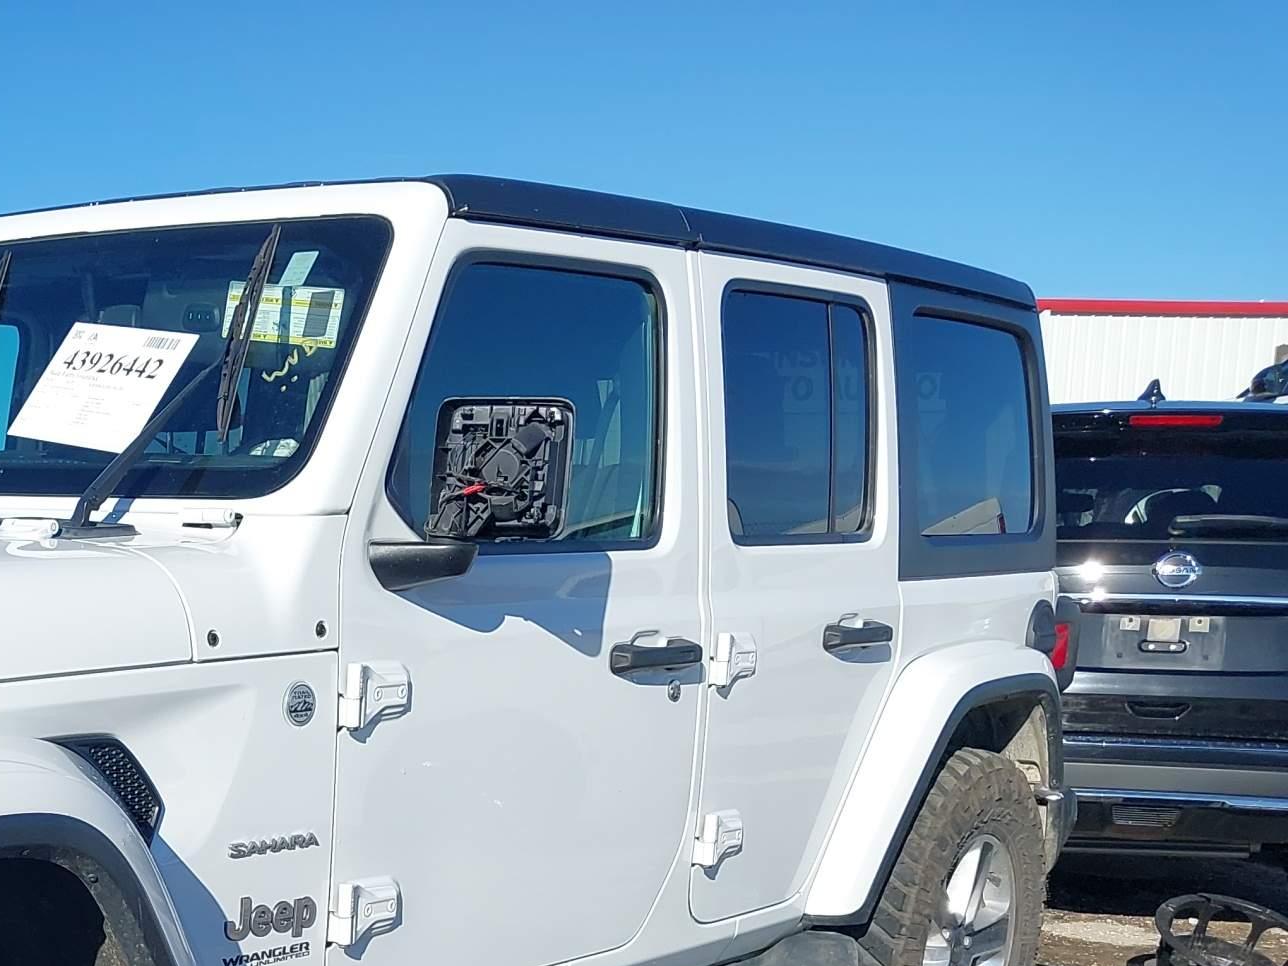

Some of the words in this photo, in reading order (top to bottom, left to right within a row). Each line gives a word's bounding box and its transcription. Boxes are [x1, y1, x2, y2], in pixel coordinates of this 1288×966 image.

[64, 349, 164, 379] 43926442
[229, 832, 320, 859] SAHARA
[223, 896, 317, 942] Jeep
